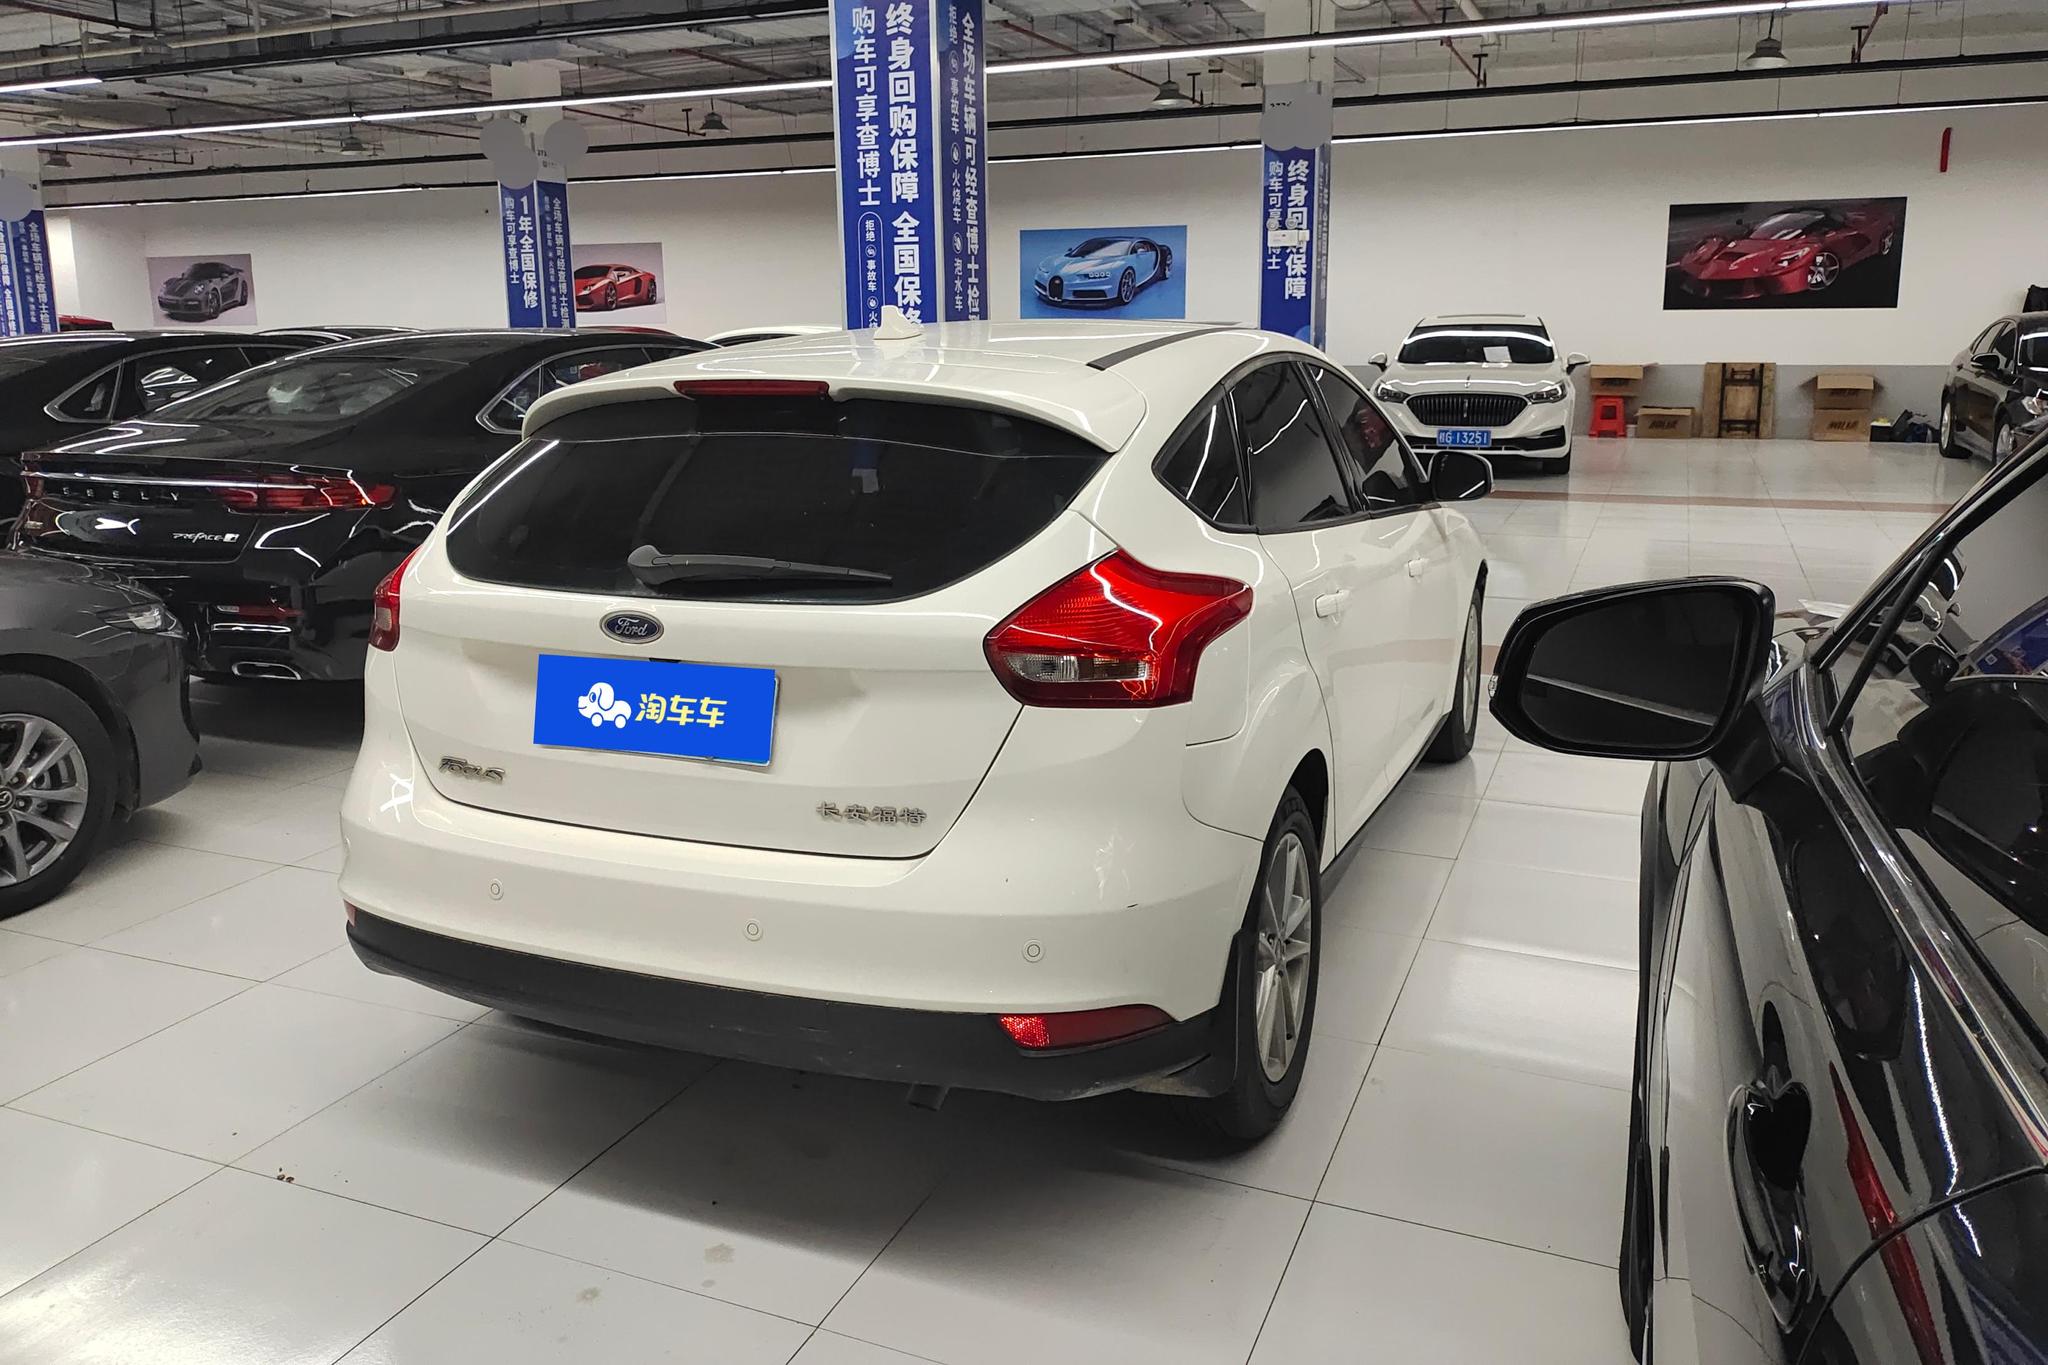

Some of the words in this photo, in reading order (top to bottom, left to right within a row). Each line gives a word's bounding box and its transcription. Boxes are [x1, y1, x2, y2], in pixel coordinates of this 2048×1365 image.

[851, 7, 882, 206] 购车可享查博士
[885, 2, 919, 204] 终身回购保障
[952, 169, 962, 225] 火烧车
[962, 12, 980, 320] 全场车辆可经查博士检
[504, 197, 520, 284] 购车可享查博士
[865, 220, 876, 242] 拒绝
[1266, 161, 1284, 270] 购车可享士
[518, 195, 539, 309] 1年全国保修
[866, 260, 877, 292] 事故车
[954, 258, 963, 312] 泡水车
[614, 617, 648, 636] Ford
[815, 800, 928, 827] 长安福特
